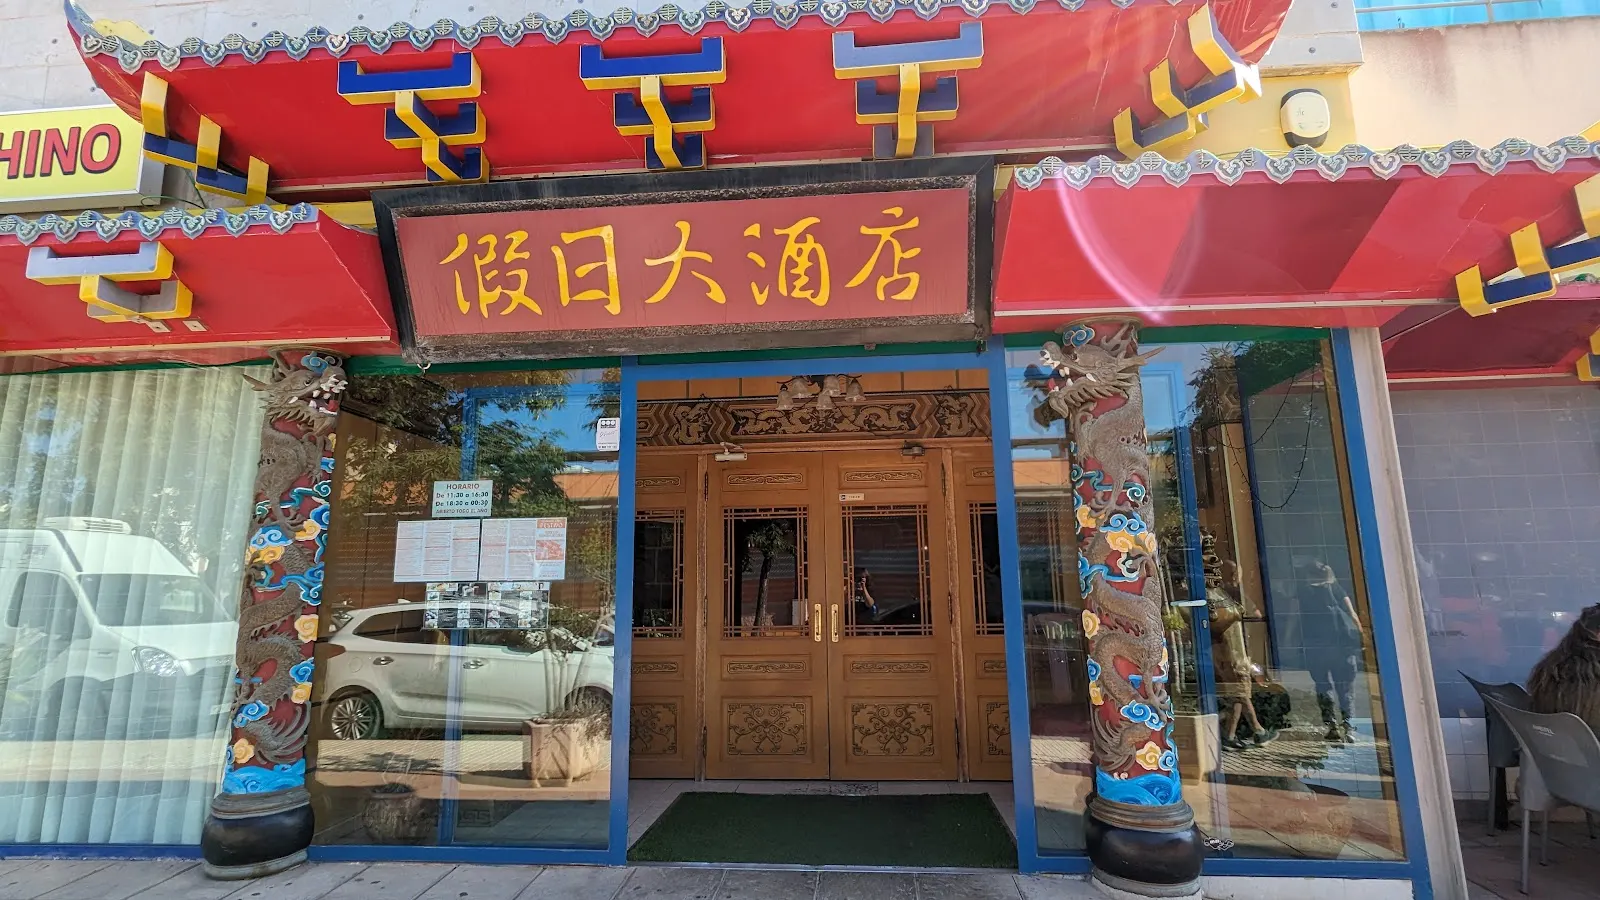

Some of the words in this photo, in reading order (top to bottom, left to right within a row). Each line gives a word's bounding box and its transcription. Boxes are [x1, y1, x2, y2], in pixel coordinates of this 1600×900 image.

[440, 206, 922, 318] 假日大酒店
